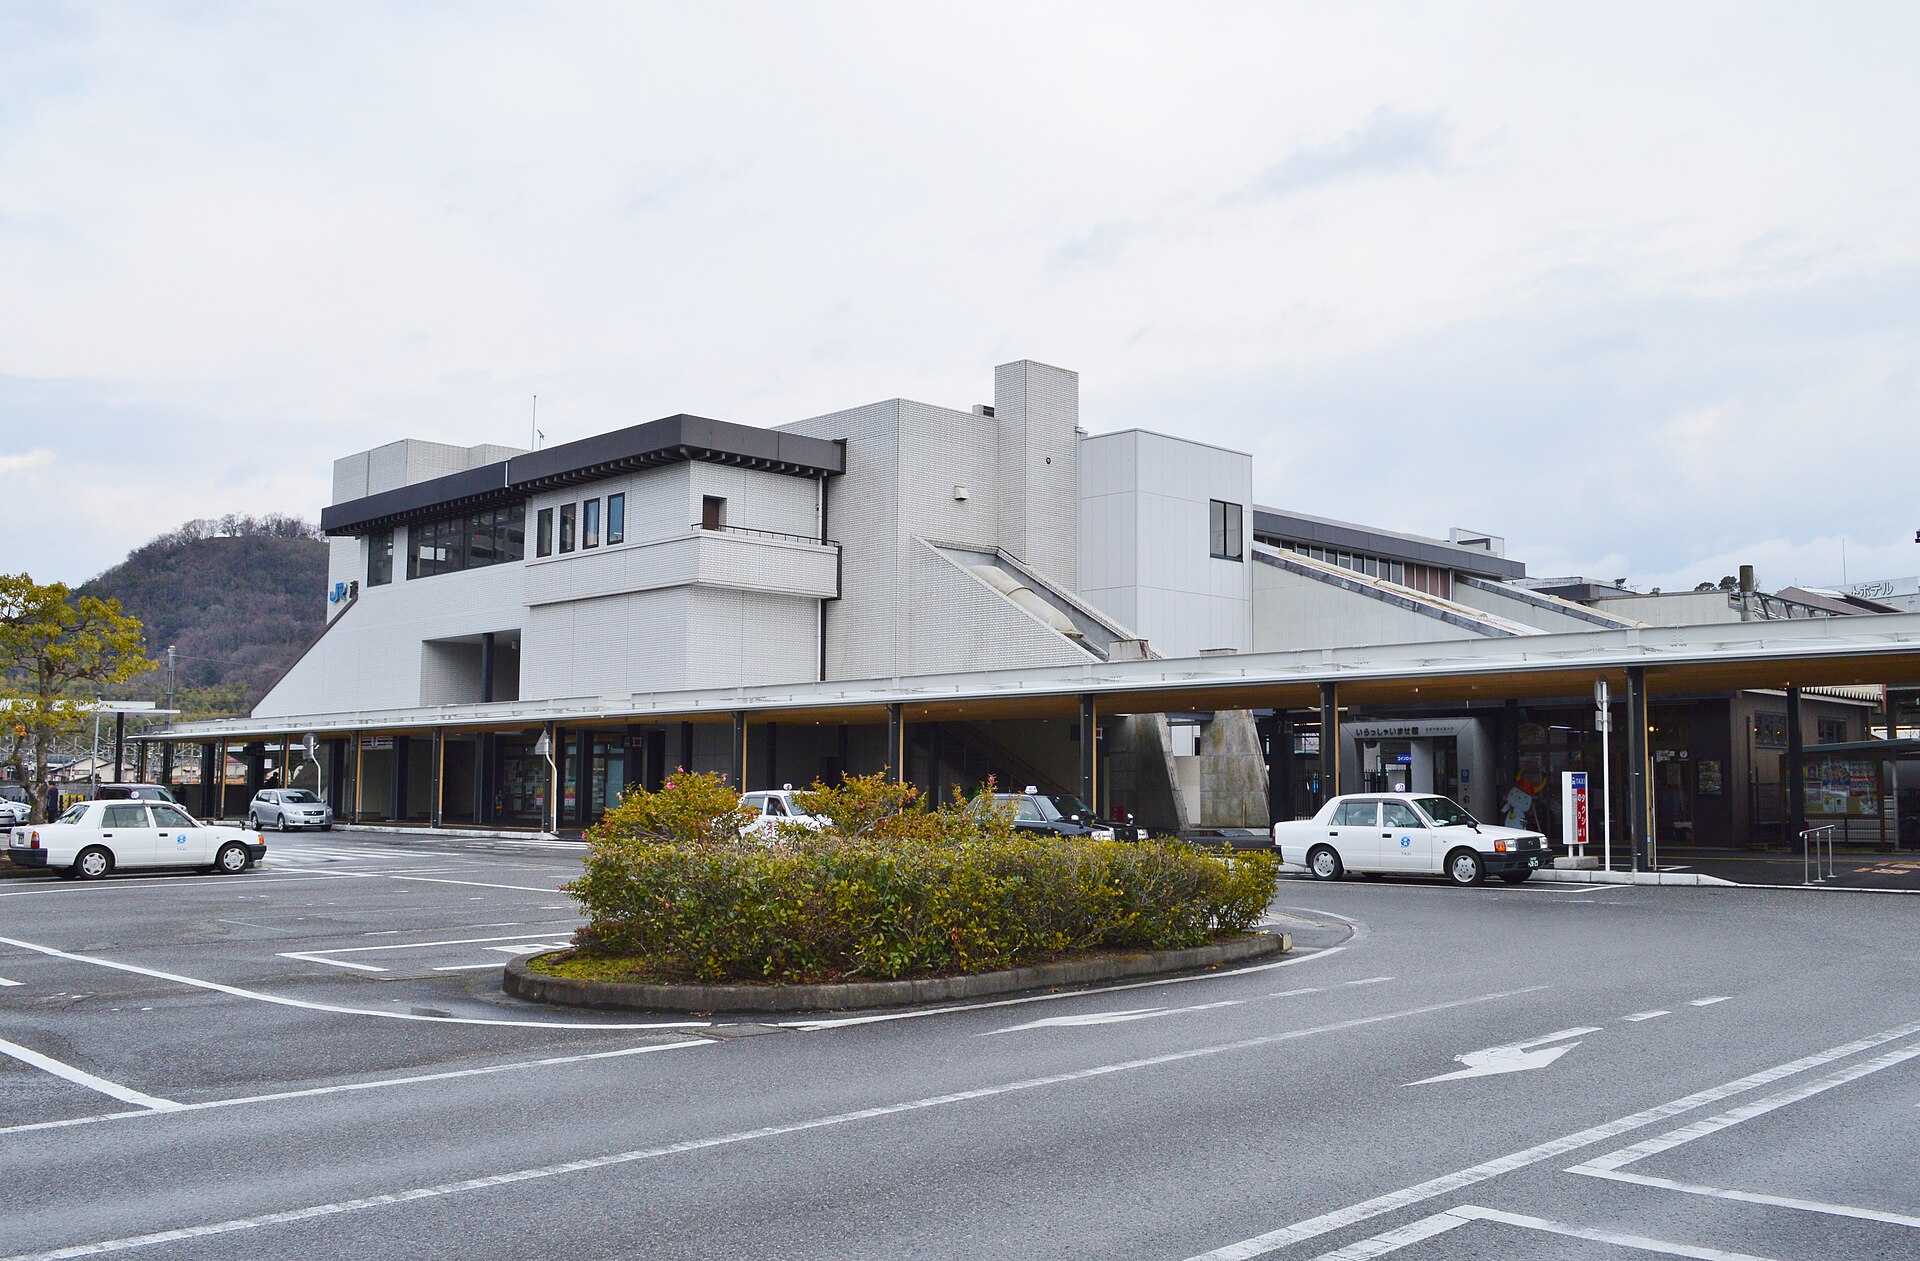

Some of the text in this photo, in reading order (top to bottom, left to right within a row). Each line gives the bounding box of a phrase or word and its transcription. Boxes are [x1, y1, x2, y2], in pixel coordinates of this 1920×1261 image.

[1355, 726, 1420, 736] いらっしゃいませ館
